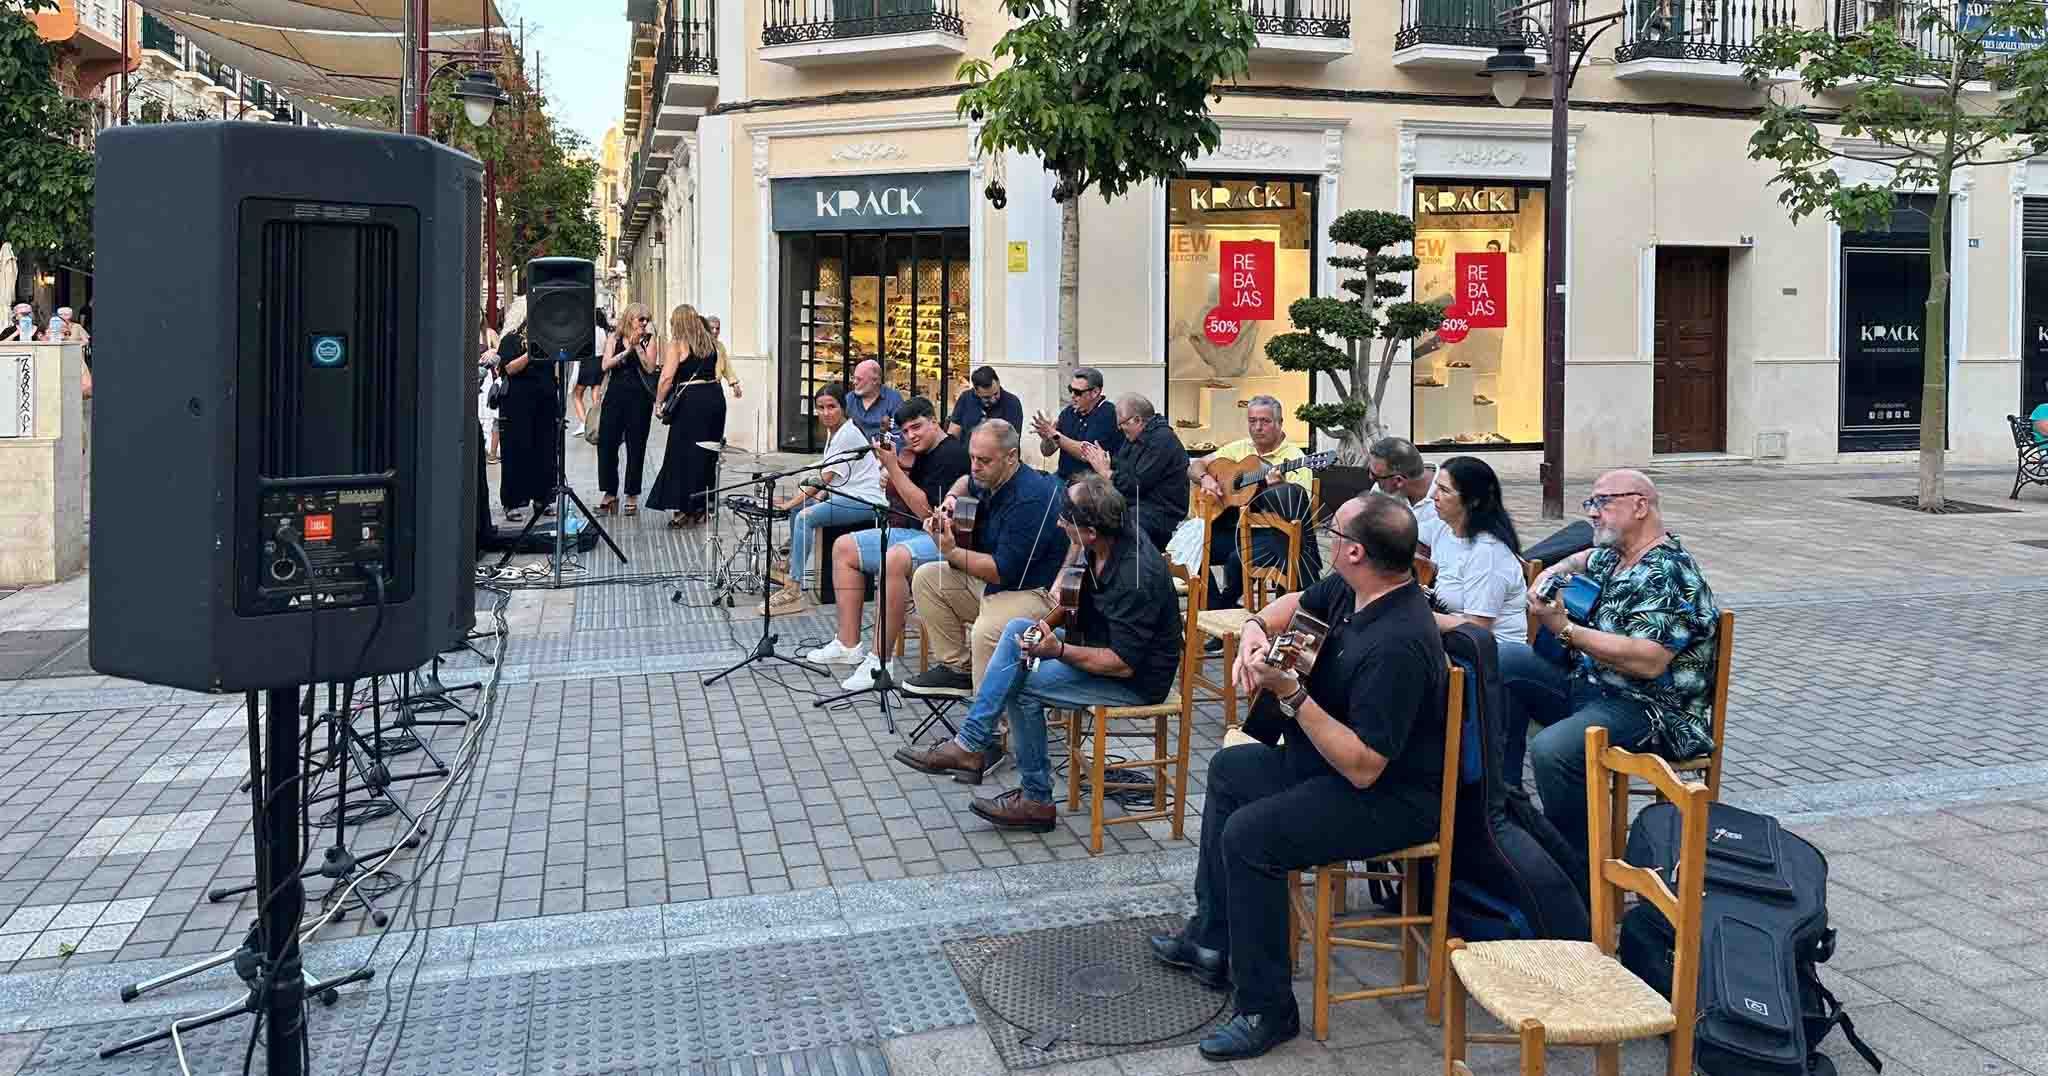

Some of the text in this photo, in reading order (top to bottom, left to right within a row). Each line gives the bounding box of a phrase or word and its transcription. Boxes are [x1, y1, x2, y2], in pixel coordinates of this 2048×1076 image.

[816, 186, 923, 216] KRACK
[1190, 186, 1283, 209] KRACK
[1418, 190, 1508, 213] KRACK
[1415, 239, 1446, 256] EW
[1233, 254, 1257, 270] RE
[1233, 273, 1257, 289] BA
[1467, 265, 1489, 281] RE
[1468, 283, 1489, 298] BA
[1232, 291, 1262, 307] JAS
[1467, 300, 1496, 316] JAS
[1206, 320, 1239, 333] -50%
[1442, 318, 1469, 330] 50%
[1861, 325, 1920, 341] KRACK
